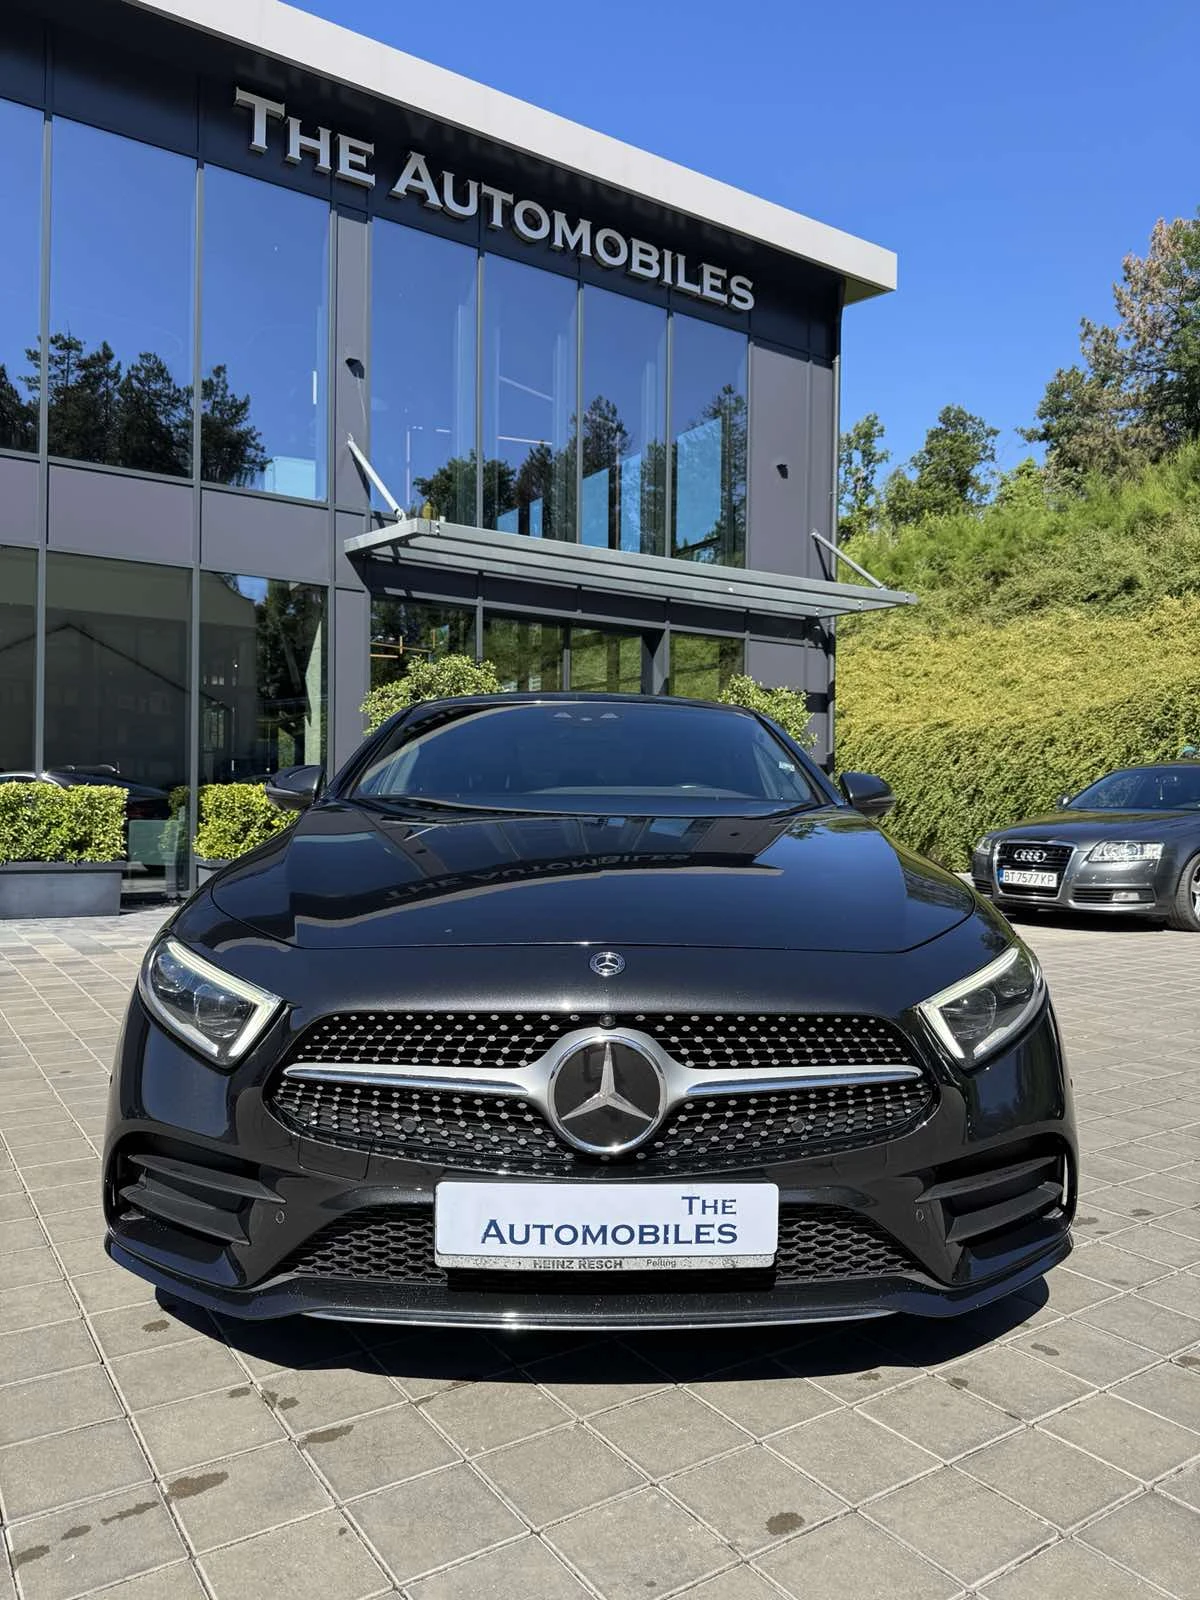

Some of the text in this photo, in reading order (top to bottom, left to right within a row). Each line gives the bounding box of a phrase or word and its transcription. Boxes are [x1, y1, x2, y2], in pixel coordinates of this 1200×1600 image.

[235, 87, 755, 311] THE AUTOMOBILES
[681, 1196, 737, 1215] THE
[481, 1219, 738, 1245] AUTOMOBILES
[533, 1259, 574, 1270] HEINZ
[578, 1258, 623, 1270] RESCH
